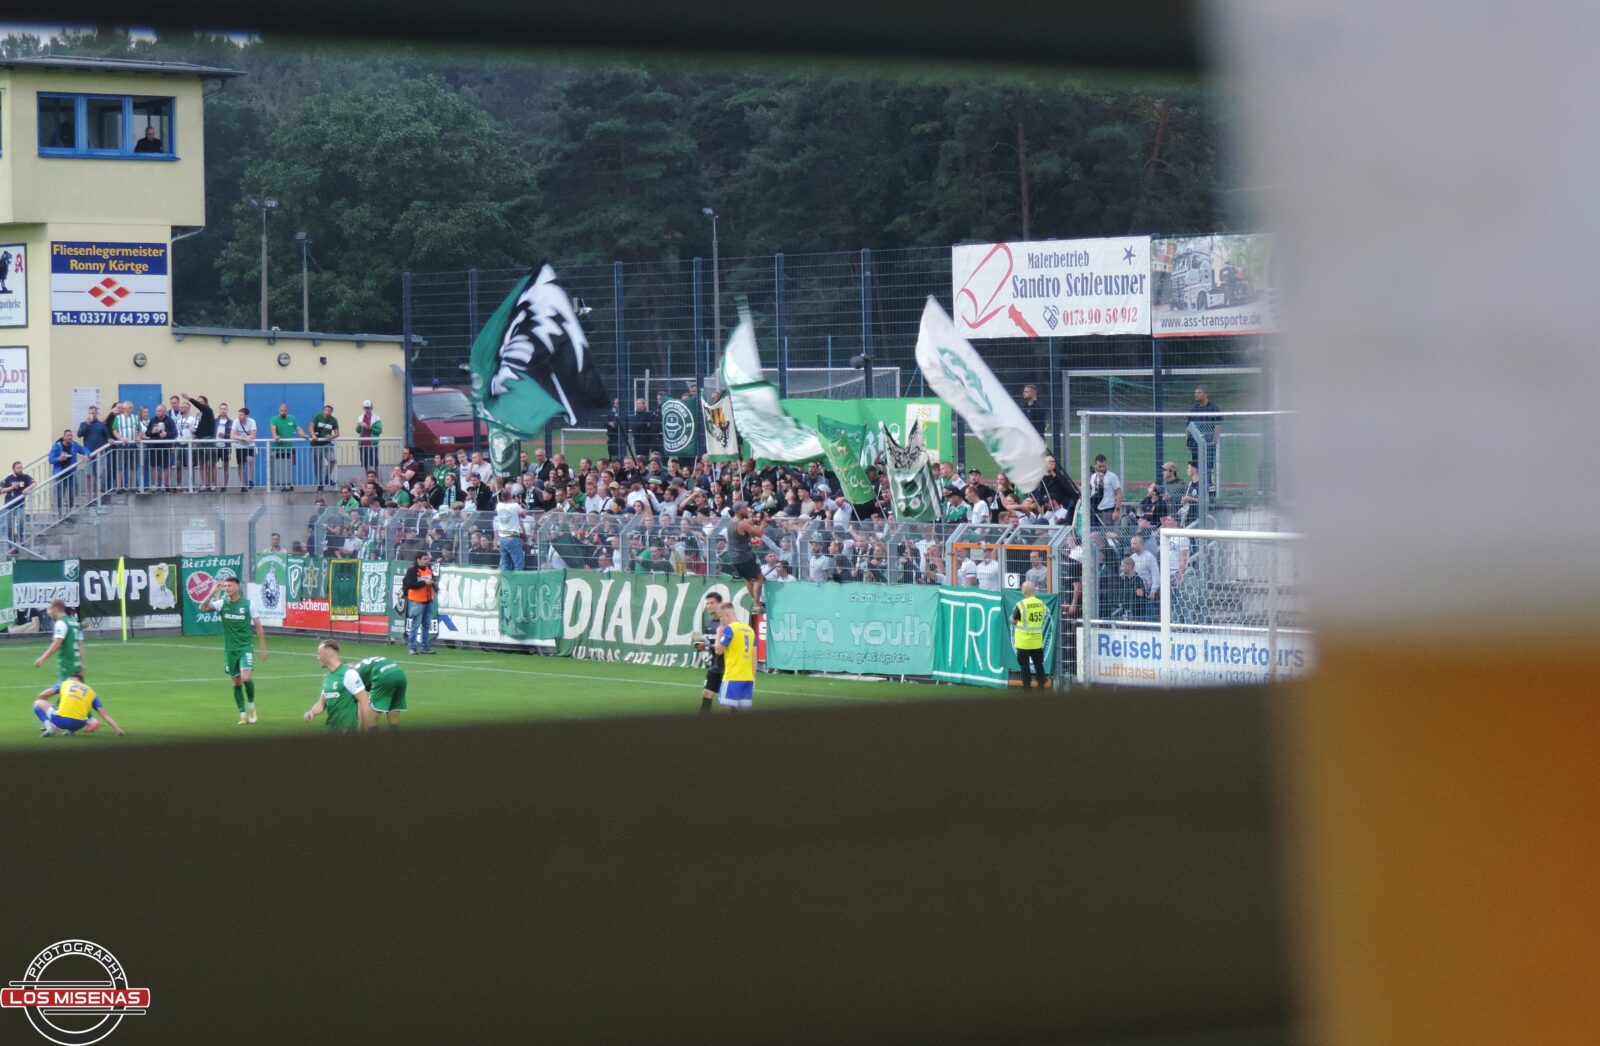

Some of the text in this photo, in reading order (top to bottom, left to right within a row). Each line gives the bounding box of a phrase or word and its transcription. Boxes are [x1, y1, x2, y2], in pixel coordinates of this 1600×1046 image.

[53, 244, 165, 258] Fliesenlegermeister
[70, 259, 148, 275] Ronny Körtge
[1027, 251, 1089, 269] Malerbetrieb
[1012, 272, 1146, 299] Sandro Schleusner
[54, 312, 166, 324] Tel.: 03371/ 64 29 99
[1121, 306, 1138, 323] 912
[1161, 313, 1262, 328] www.ass-transporte.de
[182, 556, 241, 568] Bierstand
[84, 569, 147, 601] GWP
[1007, 574, 1015, 587] C
[15, 584, 79, 604] WURZEN
[437, 573, 498, 610] CKINS
[286, 598, 330, 612] versicherun
[563, 577, 751, 646] DIABLOS
[1029, 612, 1042, 622] 455
[940, 599, 1004, 674] TRC
[1098, 662, 1156, 679] Lufthansa
[1182, 668, 1217, 683] Center
